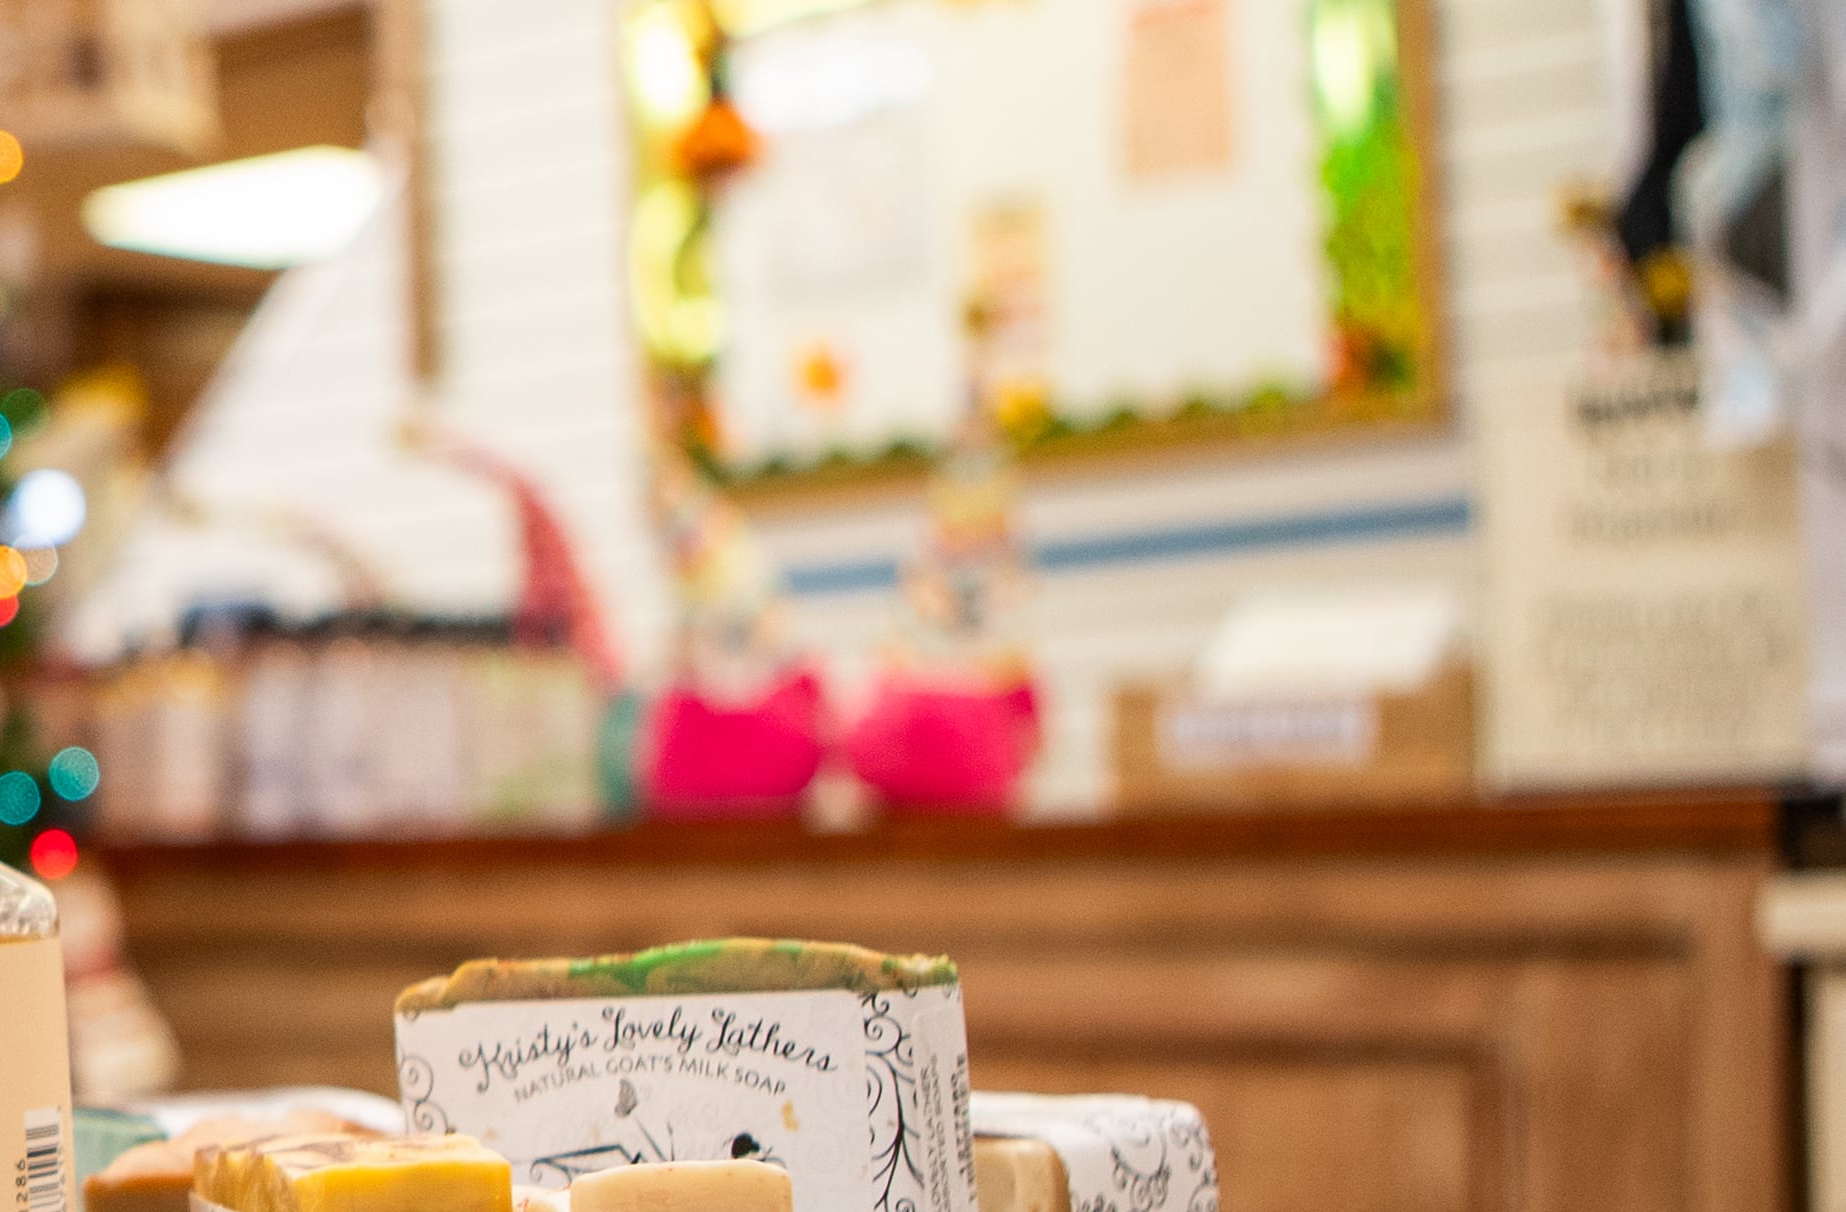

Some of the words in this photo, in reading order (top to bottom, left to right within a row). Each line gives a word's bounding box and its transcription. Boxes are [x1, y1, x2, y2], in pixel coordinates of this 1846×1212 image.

[459, 1021, 598, 1094] Kristy's
[601, 1006, 702, 1054] Lovely
[706, 1007, 839, 1073] Lathers
[513, 1062, 600, 1102] NATURAL
[605, 1054, 673, 1076] GOAT'S
[678, 1054, 729, 1080] MILK
[733, 1067, 788, 1097] SOAP
